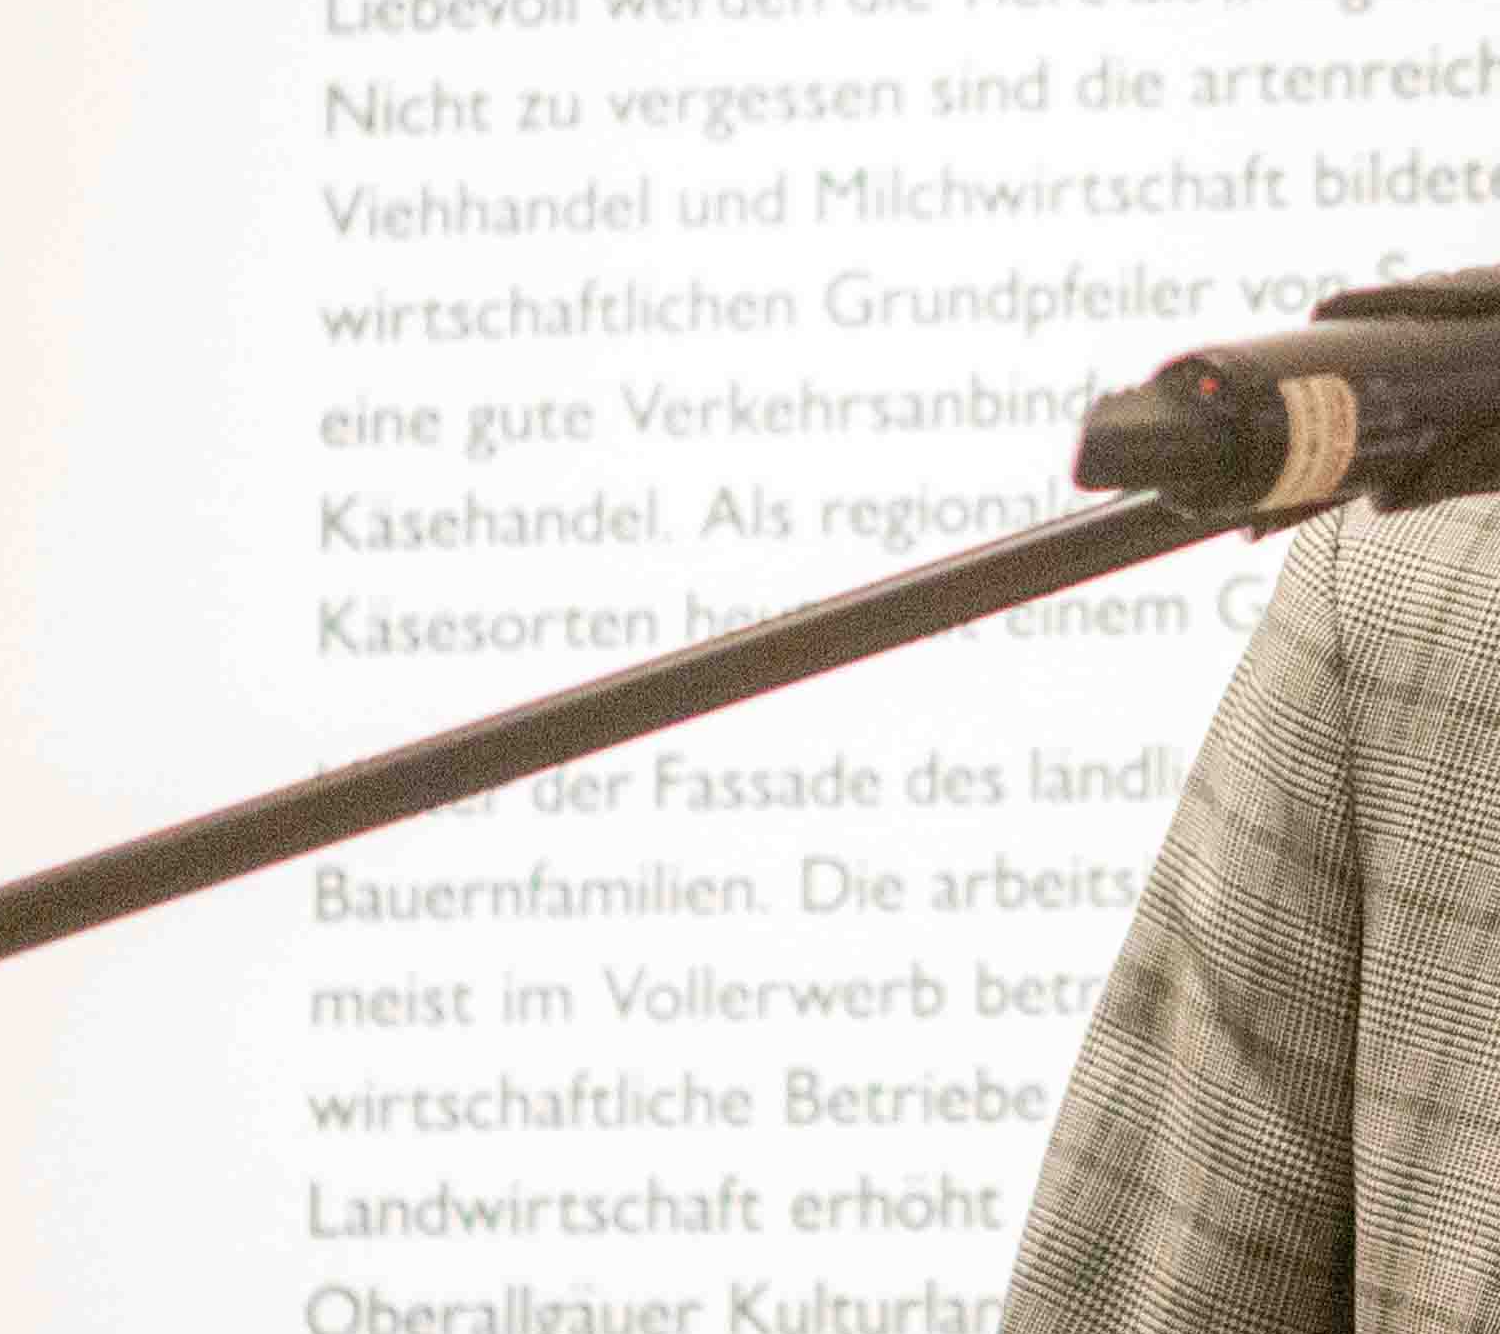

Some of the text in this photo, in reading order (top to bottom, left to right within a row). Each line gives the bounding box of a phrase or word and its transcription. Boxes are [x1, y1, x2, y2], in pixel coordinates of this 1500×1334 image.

[322, 77, 490, 139] Nicht
[515, 87, 583, 134] zu
[605, 73, 905, 142] vergessen
[928, 56, 1051, 118] sind
[1074, 54, 1166, 112] die
[319, 175, 651, 242] Viehhandel
[676, 169, 789, 231] und
[813, 148, 1291, 224] Milchwirtschaft
[317, 277, 798, 346] wirtschaftlichen
[822, 265, 1214, 340] Grundpfeiler
[316, 402, 443, 449] eine
[462, 396, 595, 463] gute
[317, 485, 672, 555] Käsehandel.
[698, 483, 795, 543] Als
[318, 597, 660, 659] Käsesorten
[534, 752, 630, 814] der
[654, 749, 882, 810] Fassade
[905, 750, 1008, 807] des
[312, 857, 768, 925] Bauernfamilien.
[800, 851, 906, 915] Die
[310, 972, 474, 1027] meist
[501, 971, 576, 1024] im
[601, 959, 949, 1024] Vollerwerb
[306, 1065, 1048, 1135] wirtschaftliche Betriebe
[308, 1170, 1004, 1243] Landwirtschaft erhöht
